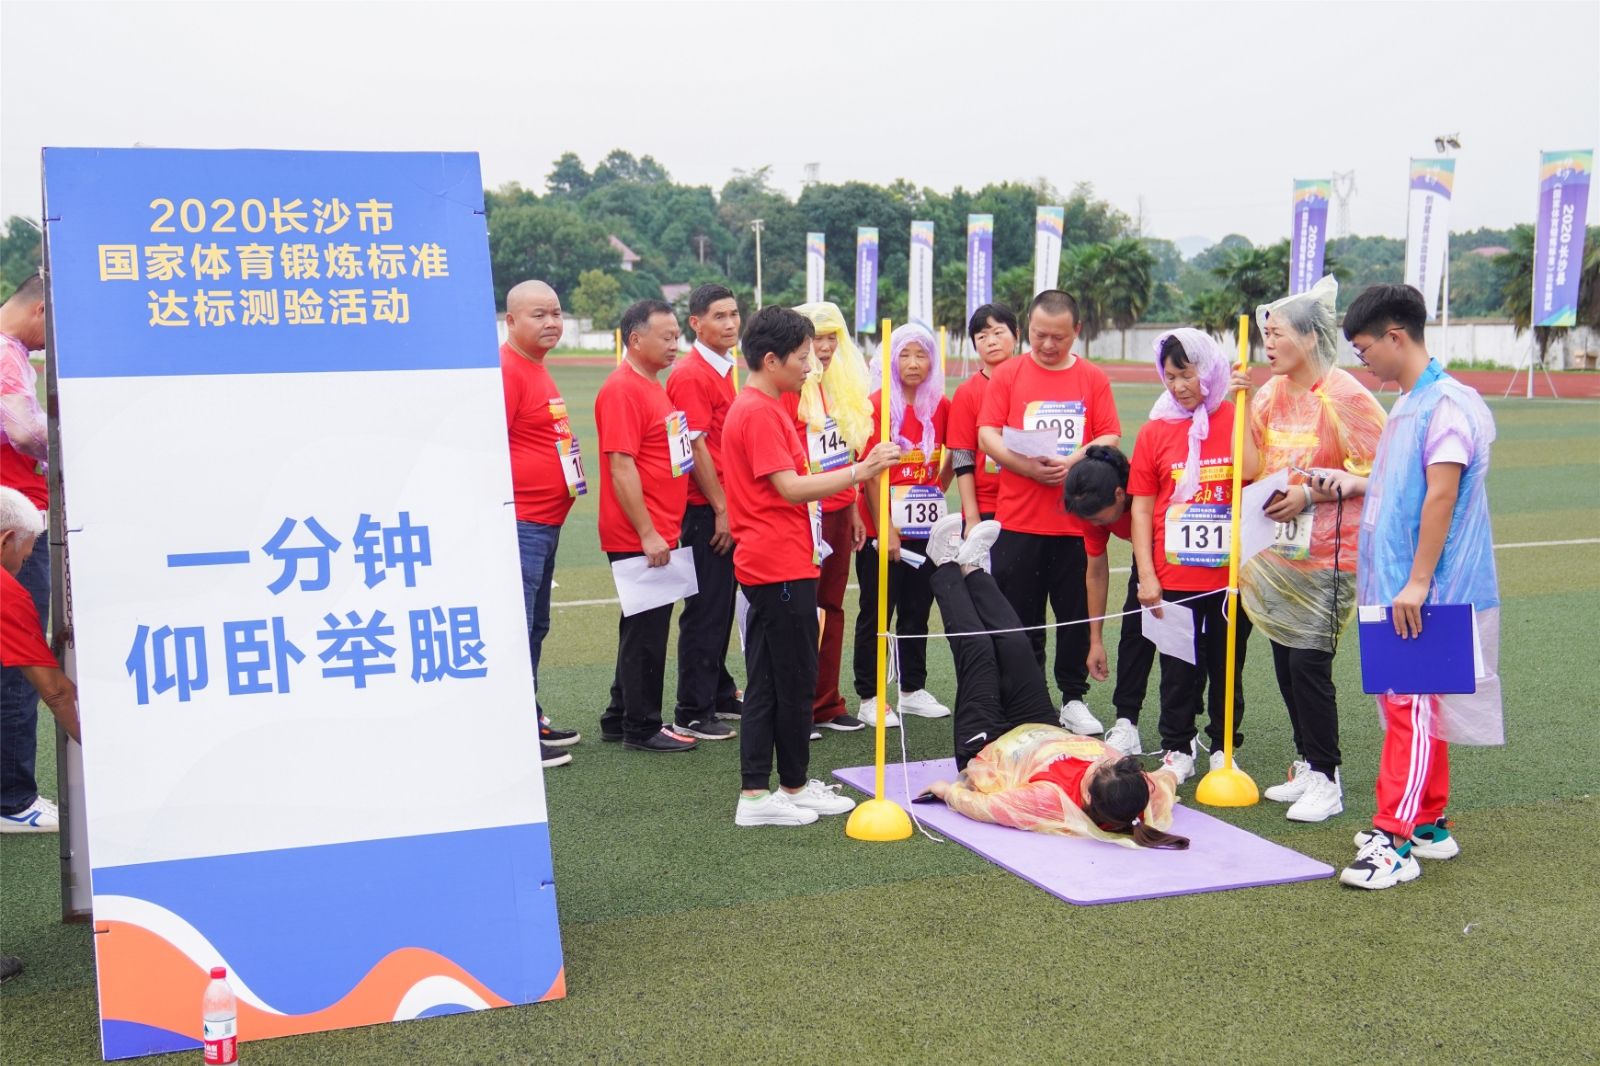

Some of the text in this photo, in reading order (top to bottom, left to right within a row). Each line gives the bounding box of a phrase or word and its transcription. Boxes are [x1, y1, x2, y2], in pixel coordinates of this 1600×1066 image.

[150, 198, 393, 235] 2020长沙市
[98, 242, 450, 282] 国家体育锻炼标准
[147, 287, 410, 327] 达标测验活动
[904, 502, 939, 524] 138
[166, 511, 433, 596] 一分钟
[1181, 524, 1223, 549] 131
[124, 606, 489, 705] 仰卧举腿
